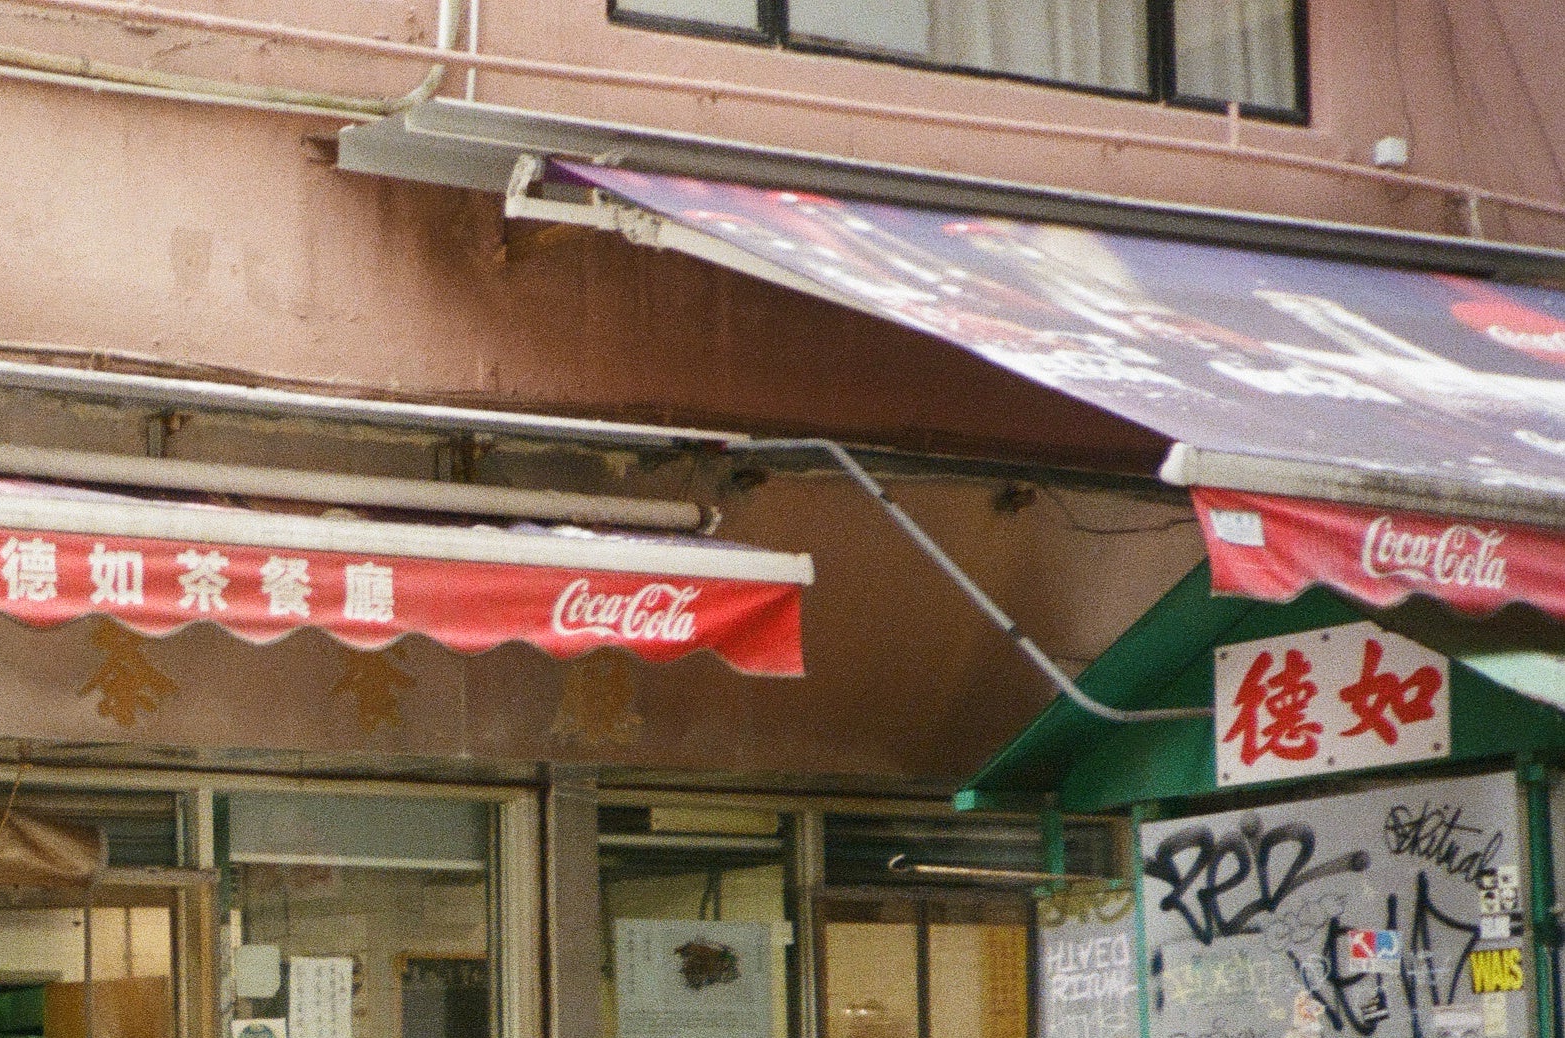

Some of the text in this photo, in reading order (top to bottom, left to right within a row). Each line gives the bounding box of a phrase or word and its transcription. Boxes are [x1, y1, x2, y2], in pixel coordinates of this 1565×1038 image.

[0, 536, 396, 624] 德如茶餐廳
[1222, 638, 1444, 767] 德如
